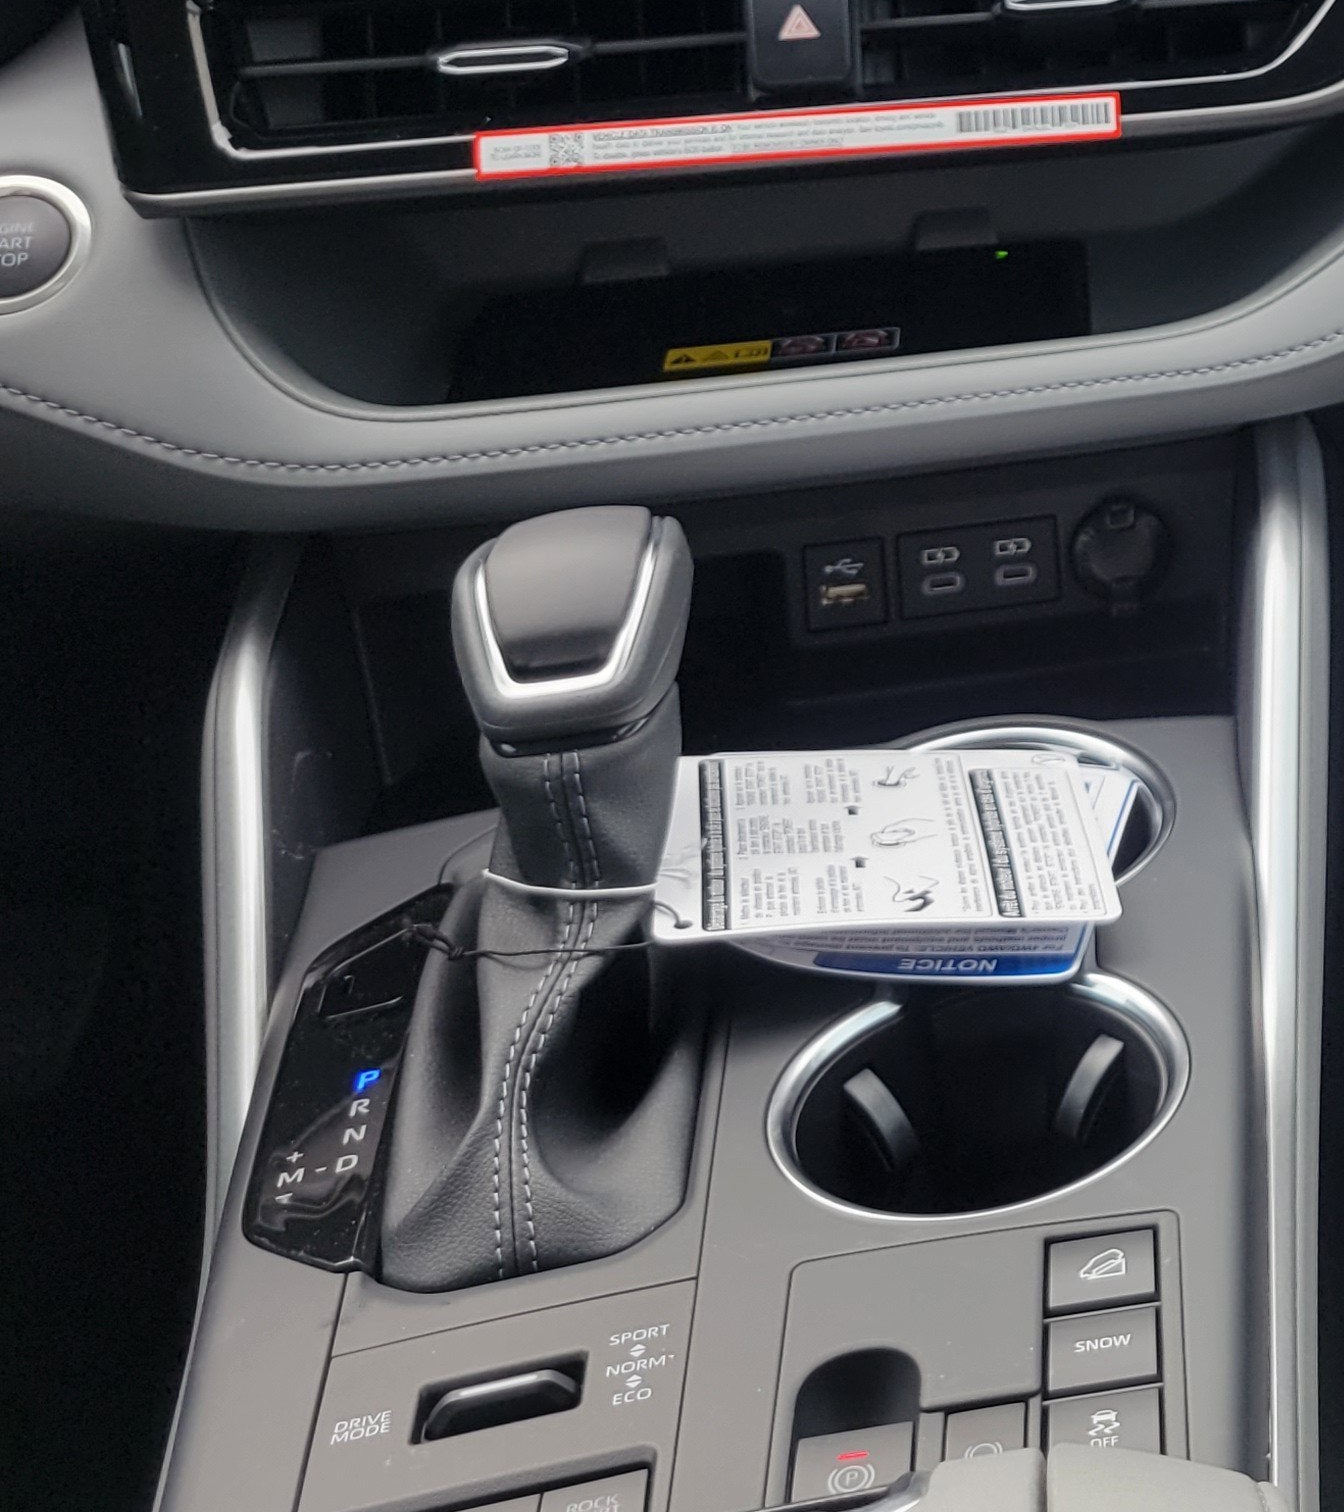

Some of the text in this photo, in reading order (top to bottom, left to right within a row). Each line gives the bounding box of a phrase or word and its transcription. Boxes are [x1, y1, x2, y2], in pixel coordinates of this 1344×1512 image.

[0, 236, 32, 250] ART
[0, 252, 29, 267] OP
[899, 958, 998, 973] NOTICE
[357, 1069, 382, 1091] P
[349, 1098, 371, 1117] R
[342, 1125, 368, 1146] N
[277, 1168, 305, 1188] M
[335, 1155, 359, 1174] D
[609, 1323, 671, 1347] SPORT
[1073, 1333, 1132, 1353] SNOW
[612, 1387, 653, 1406] ECO
[334, 1410, 393, 1434] DRIVE
[330, 1421, 391, 1447] MODE
